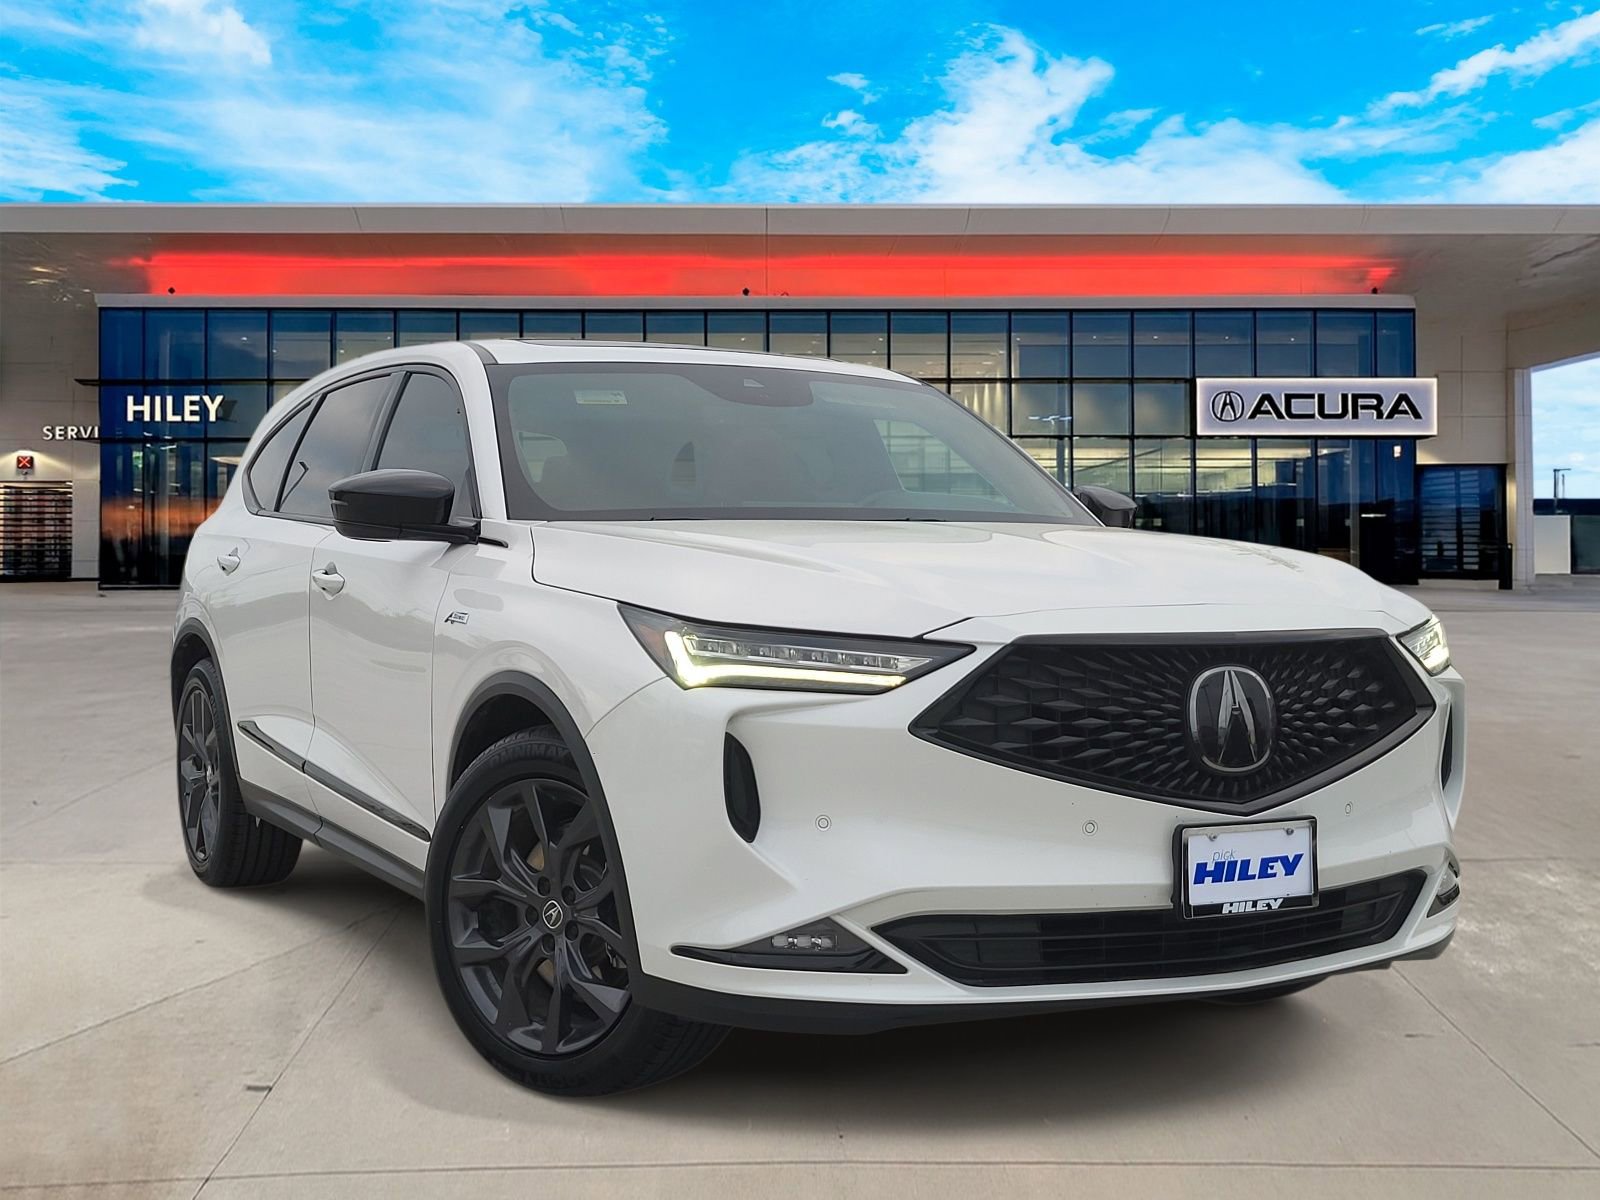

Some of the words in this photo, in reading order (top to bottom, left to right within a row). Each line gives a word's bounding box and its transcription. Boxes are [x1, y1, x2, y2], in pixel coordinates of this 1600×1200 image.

[126, 395, 224, 422] HILEY
[1247, 392, 1423, 420] ACURA
[42, 425, 99, 440] SERVI
[1193, 853, 1304, 885] HILEY
[1222, 898, 1283, 914] HILEY
